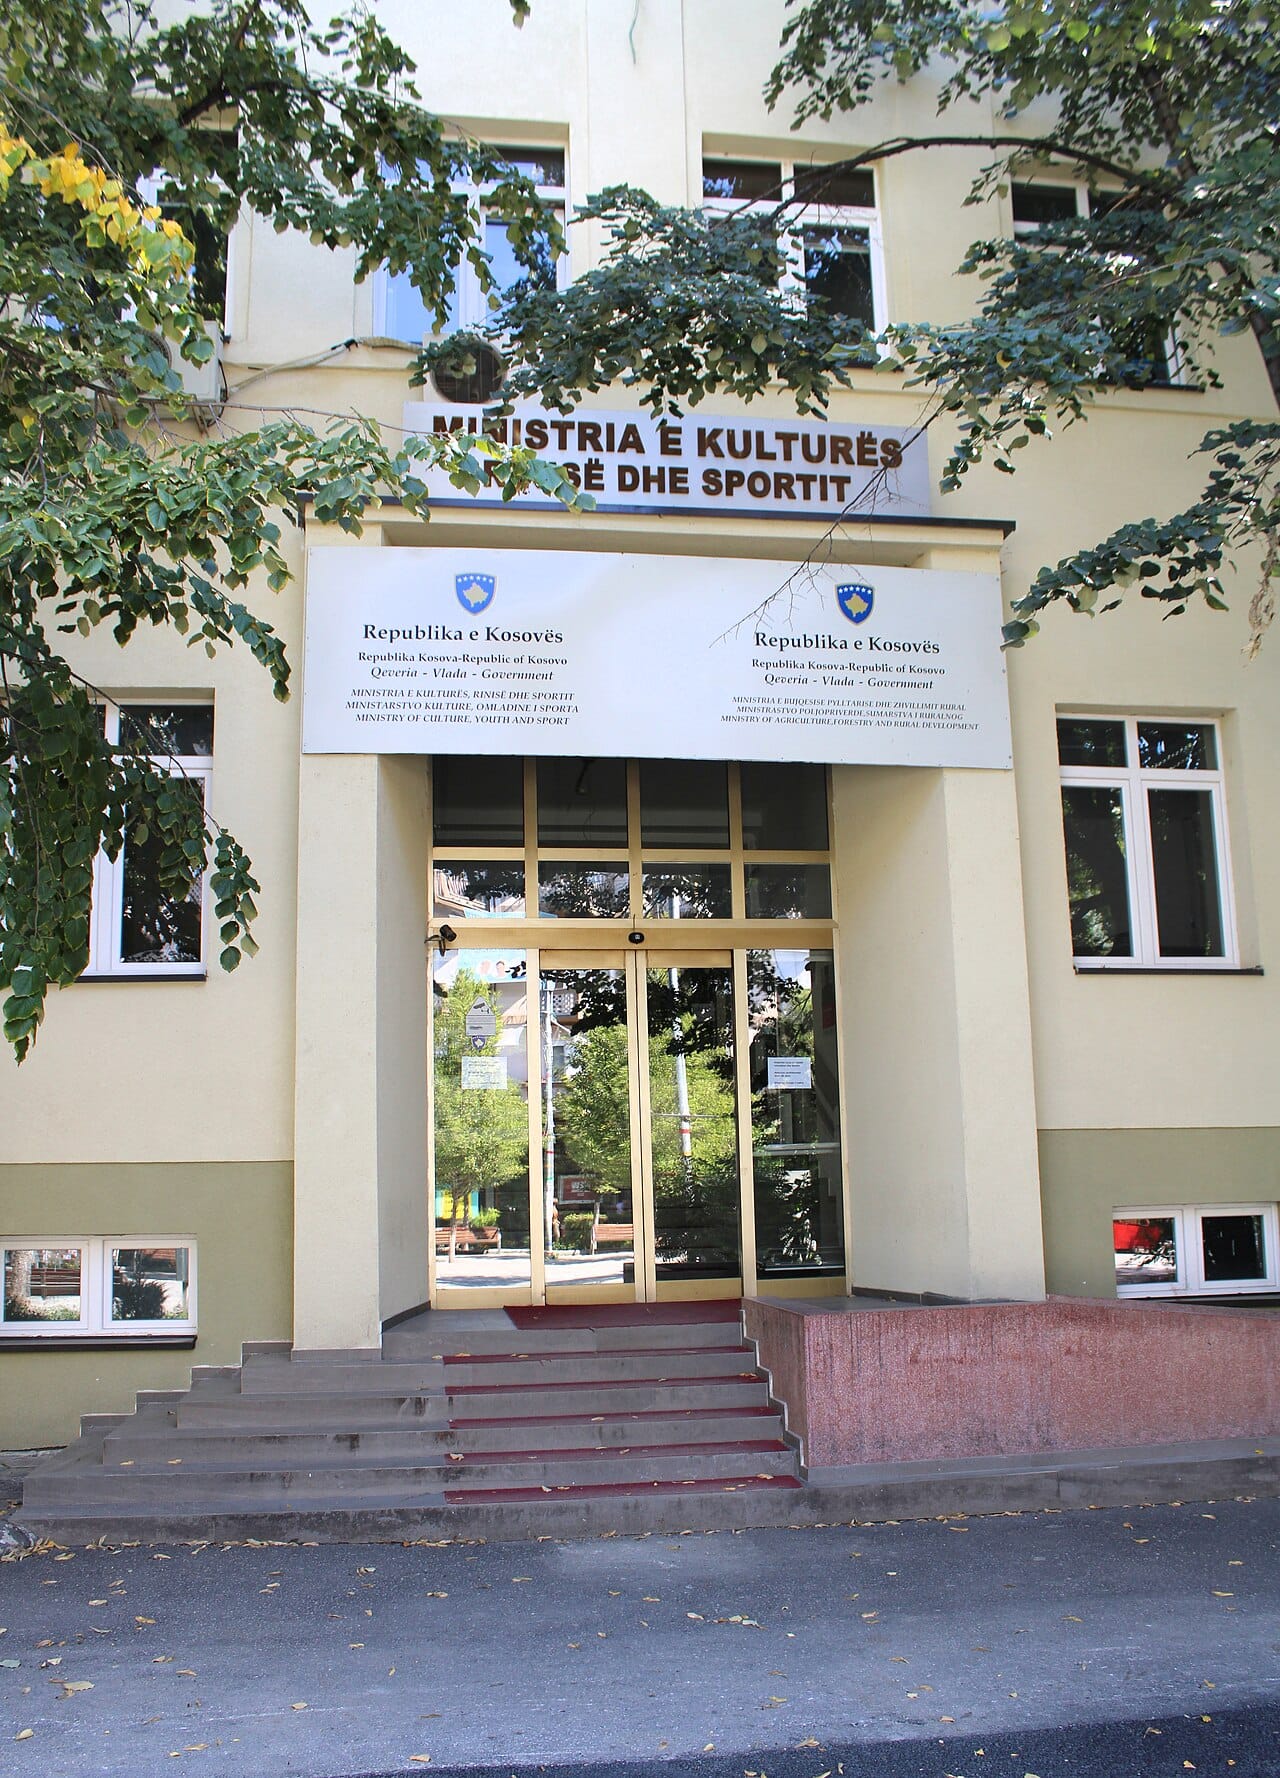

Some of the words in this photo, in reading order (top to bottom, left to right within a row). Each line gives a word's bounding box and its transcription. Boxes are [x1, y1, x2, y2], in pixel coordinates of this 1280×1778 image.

[659, 426, 683, 456] E
[698, 427, 903, 469] KULTURËS
[617, 465, 690, 495] DHE
[703, 467, 852, 503] SPORTIT
[363, 623, 463, 644] Republika
[469, 629, 479, 641] e
[486, 626, 564, 643] Kosovës
[754, 631, 848, 652] Republika
[854, 638, 863, 651] e
[869, 636, 940, 654] Kosovës
[358, 651, 415, 664] Republika
[418, 653, 511, 665] Kosova-Republic
[513, 653, 525, 664] of
[527, 655, 568, 665] Kosovo
[370, 667, 418, 679] Qeveria
[433, 668, 468, 679] Vlada
[481, 669, 554, 681] Government
[752, 658, 805, 671] Republika
[808, 660, 893, 674] Kosova-Republic
[895, 663, 907, 673] of
[909, 665, 946, 676] Kosovo
[764, 673, 809, 686] Qeveria
[822, 676, 855, 687] Vlada
[867, 677, 934, 690] Government
[350, 688, 405, 698] MINISTRIA
[407, 689, 414, 698] E
[416, 689, 470, 700] KULTURËS,
[473, 689, 506, 699] RINISË
[508, 692, 530, 700] DHE
[532, 692, 575, 701] SPORTIT
[345, 701, 422, 710] MINISTARSTVO
[424, 702, 474, 712] KULTURE,
[476, 702, 531, 712] OMLADINE
[533, 704, 538, 712] I
[540, 704, 579, 713] SPORTA
[732, 696, 775, 704] MINISTRIA
[777, 697, 782, 705] E
[784, 697, 825, 706] BUJQESISE
[875, 701, 892, 709] DHE
[940, 703, 966, 711] RURAL
[355, 713, 405, 722] MINISTRY
[407, 714, 421, 723] OF
[423, 714, 472, 724] CULTURE,
[475, 715, 510, 724] YOUTH
[512, 716, 535, 725] AND
[536, 717, 570, 725] SPORT
[736, 705, 798, 715] MINISTRASTVO
[919, 711, 964, 720] RURALNOG
[720, 714, 760, 723] MINISTRY
[875, 720, 892, 728] AND
[893, 720, 921, 729] RURAL
[922, 722, 980, 731] DEVELOPMENT
